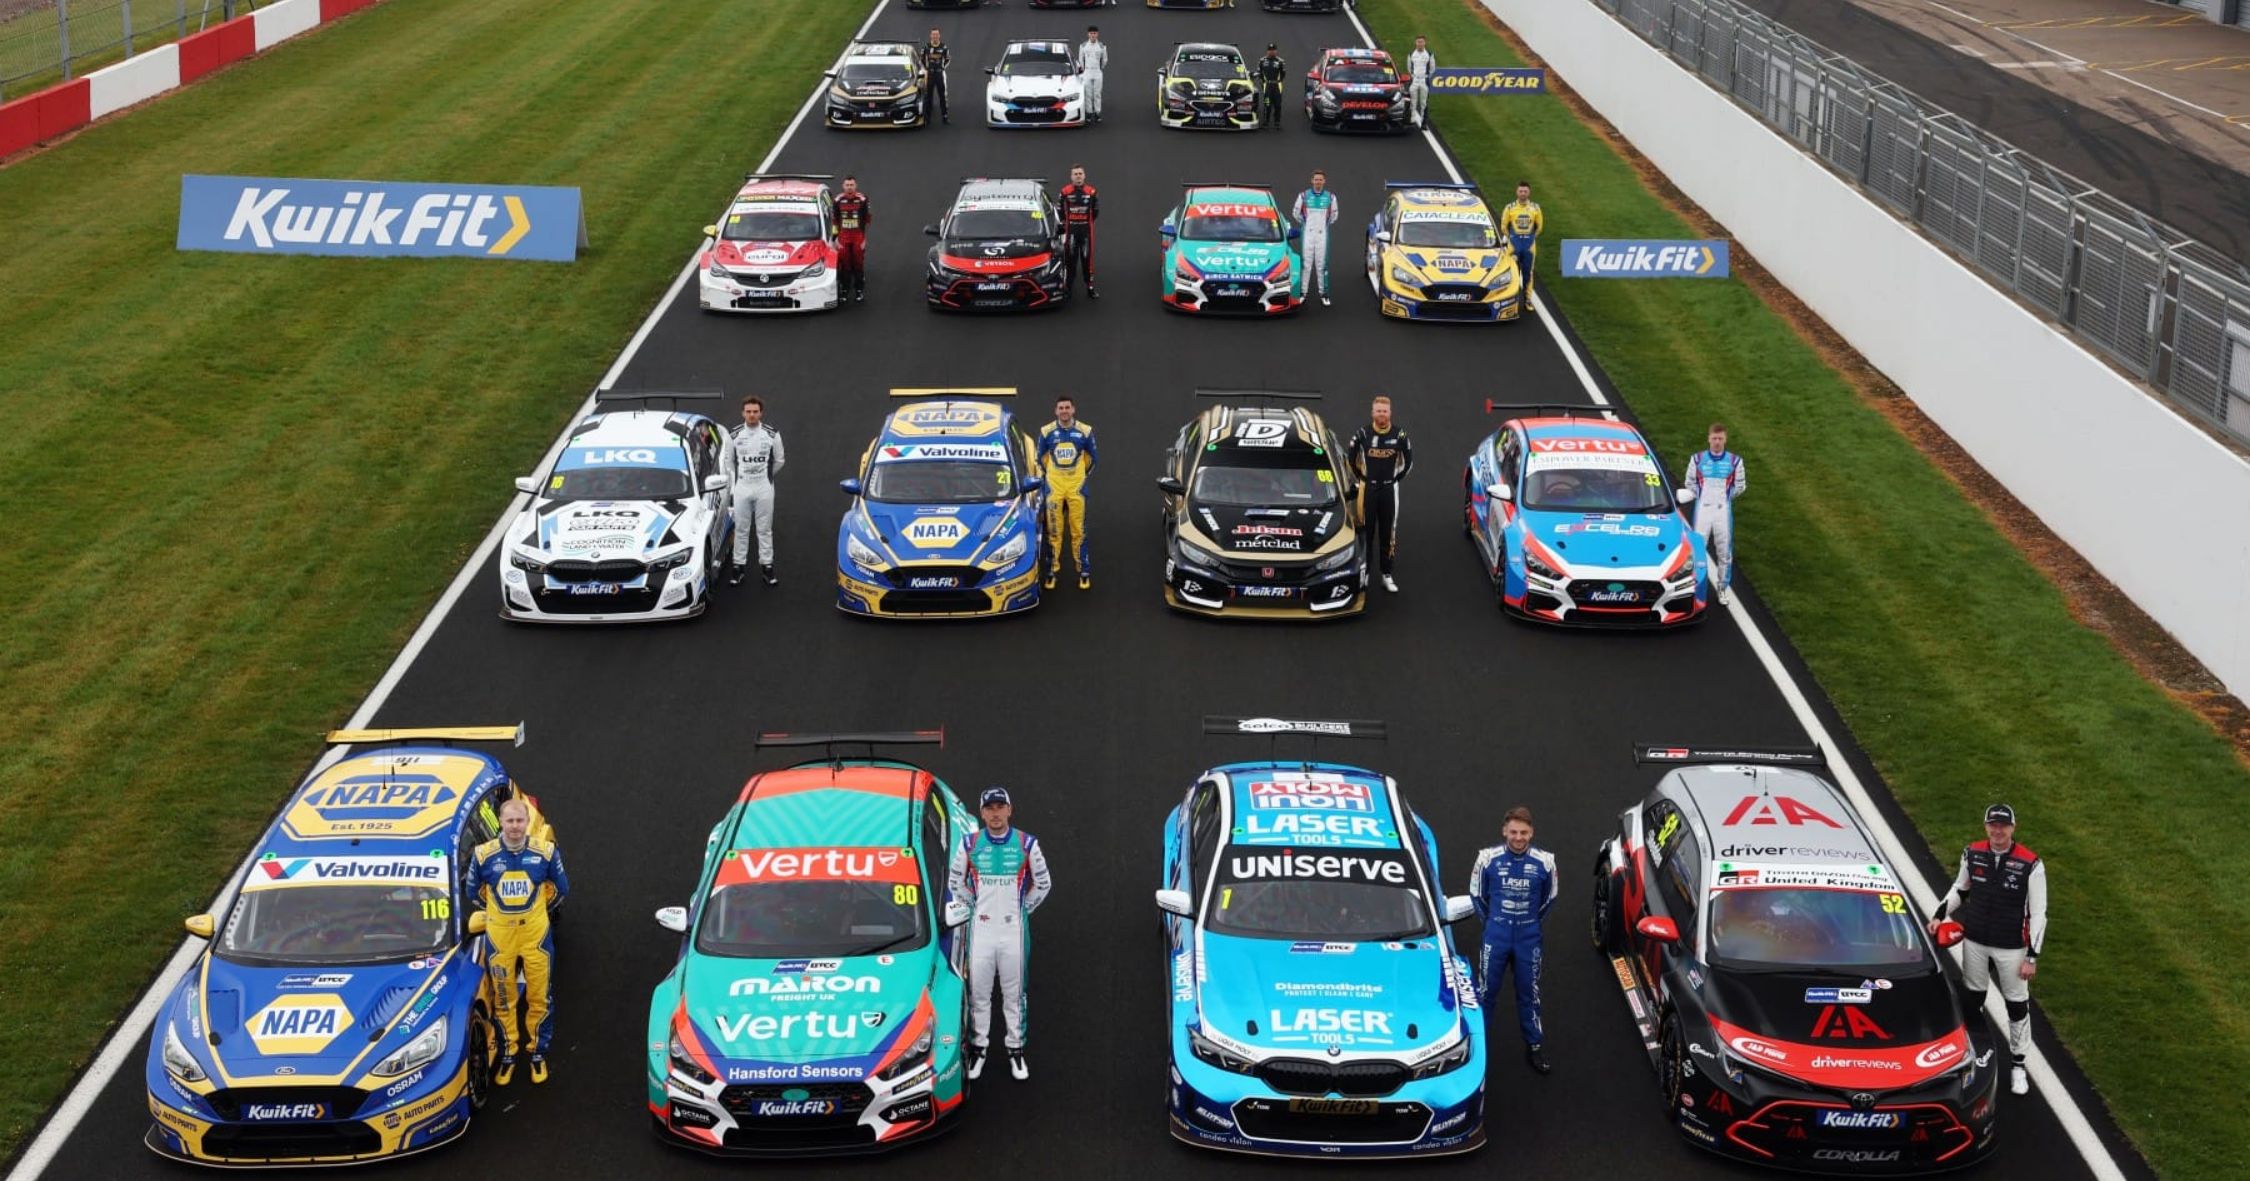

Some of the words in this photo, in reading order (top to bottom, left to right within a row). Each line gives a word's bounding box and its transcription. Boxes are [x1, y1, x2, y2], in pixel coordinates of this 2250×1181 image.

[1432, 74, 1539, 91] GOODYEAR
[914, 412, 981, 421] NAPA
[584, 449, 657, 464] LKQ
[920, 447, 1001, 458] Valvoline
[913, 525, 959, 538] NAPA
[326, 784, 430, 805] NAPA
[360, 822, 393, 830] 1925
[1246, 813, 1384, 838] LASER
[1292, 834, 1341, 845] TOOLS
[314, 861, 440, 878] Valvoline
[501, 878, 529, 897] NAPA
[1501, 877, 1530, 888] LASER
[1765, 877, 1817, 885] United
[1827, 878, 1896, 891] Kingdom
[893, 884, 917, 905] 80
[1221, 888, 1232, 910] 1
[420, 898, 450, 920] 116
[1879, 894, 1907, 914] 52
[1275, 982, 1383, 993] Diamondbrite
[771, 993, 817, 1002] FREIGHT
[820, 993, 836, 1001] UK
[261, 1008, 336, 1035] NAPA
[1270, 1008, 1394, 1035] LASER
[1311, 1033, 1355, 1045] TOOLS
[1811, 1056, 1902, 1070] driverreviews
[729, 1067, 798, 1079] Hansford
[801, 1065, 863, 1078] Sensors
[387, 1071, 423, 1097] OSRAM
[898, 1101, 929, 1115] OCTANE
[1813, 1149, 1900, 1161] COROLLA
